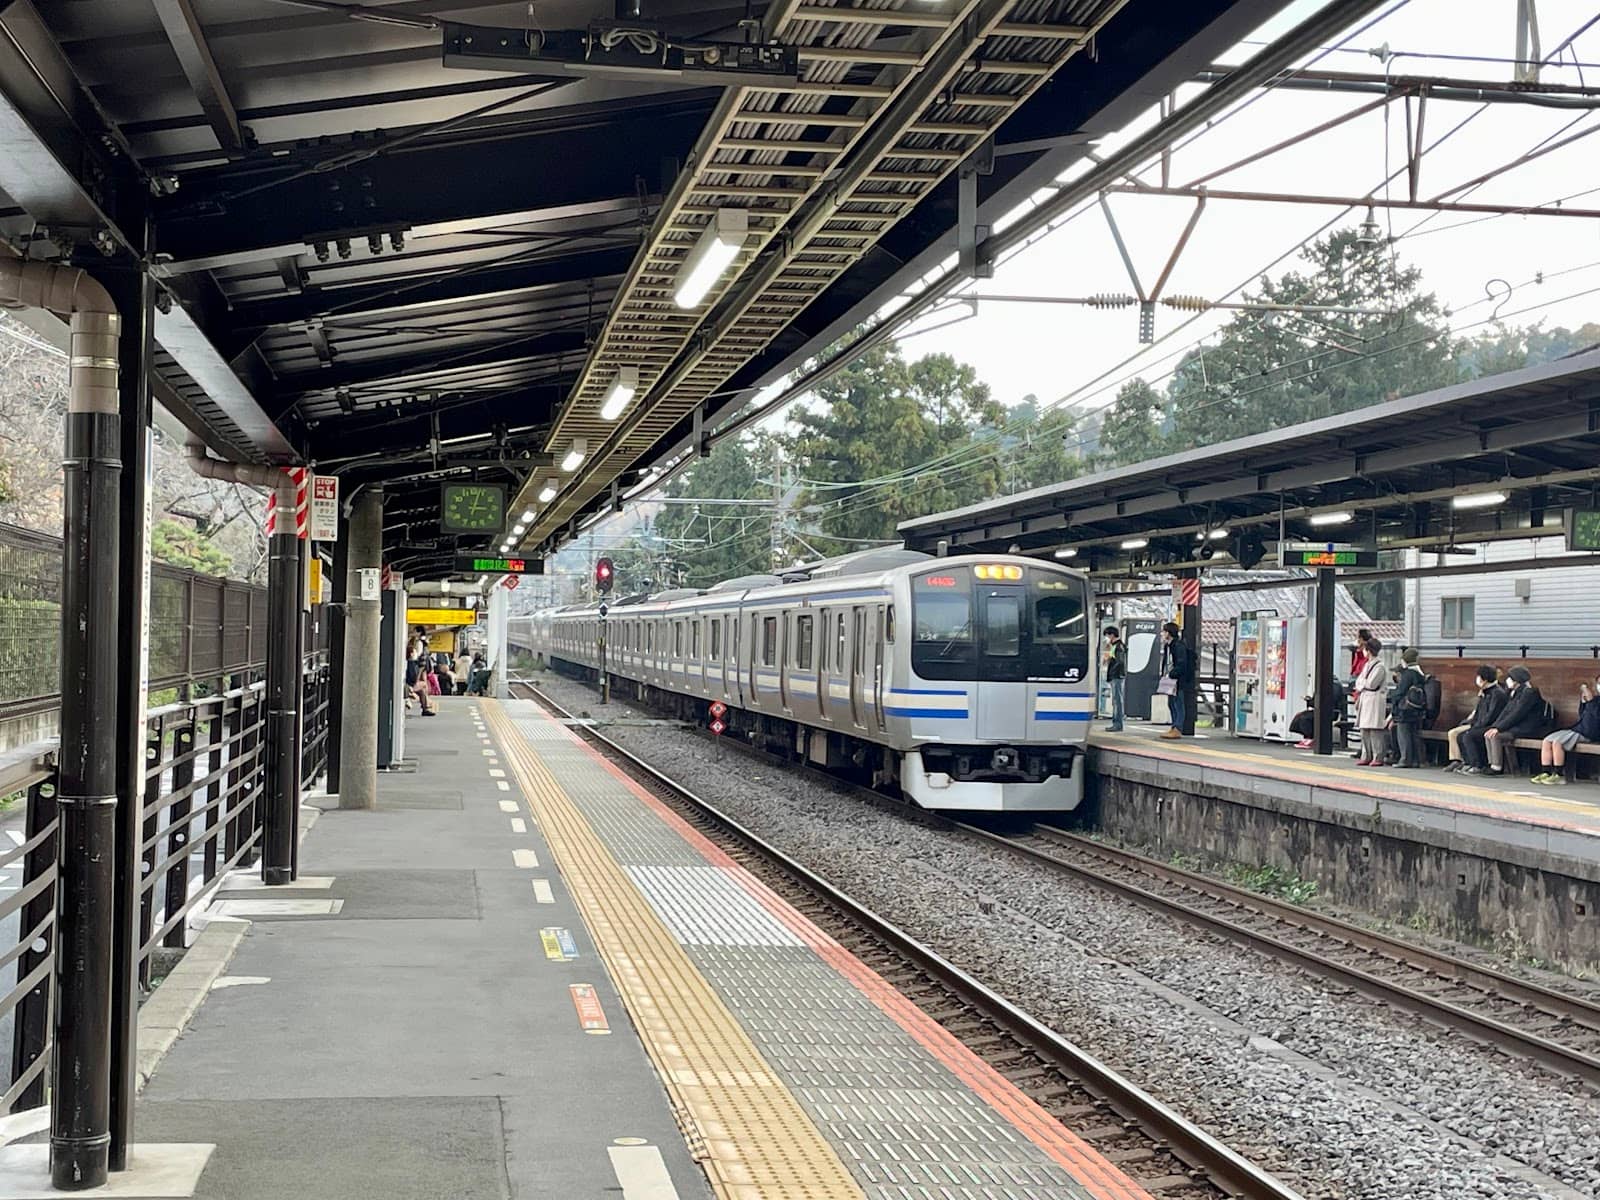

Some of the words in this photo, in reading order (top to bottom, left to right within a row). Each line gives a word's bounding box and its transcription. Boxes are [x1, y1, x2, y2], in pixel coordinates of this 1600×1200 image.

[316, 478, 335, 486] STOP
[368, 578, 374, 590] 8
[1065, 668, 1079, 677] JR
